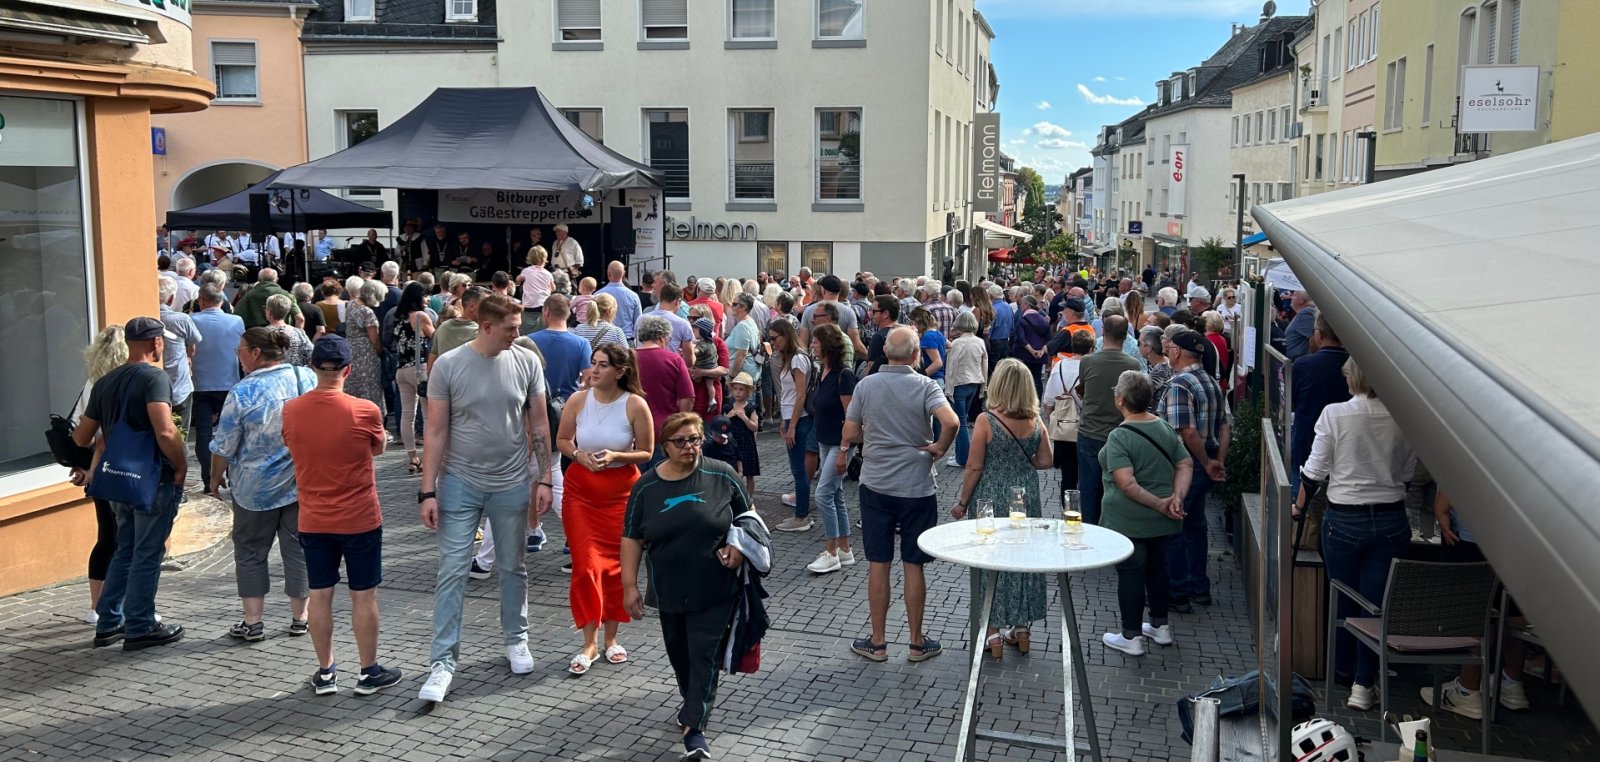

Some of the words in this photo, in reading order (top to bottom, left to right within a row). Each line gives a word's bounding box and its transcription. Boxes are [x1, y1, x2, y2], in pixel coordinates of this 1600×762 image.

[1468, 97, 1531, 107] eselsohr
[497, 191, 561, 207] Bitburger
[470, 206, 588, 222] Gäßestrepperfes
